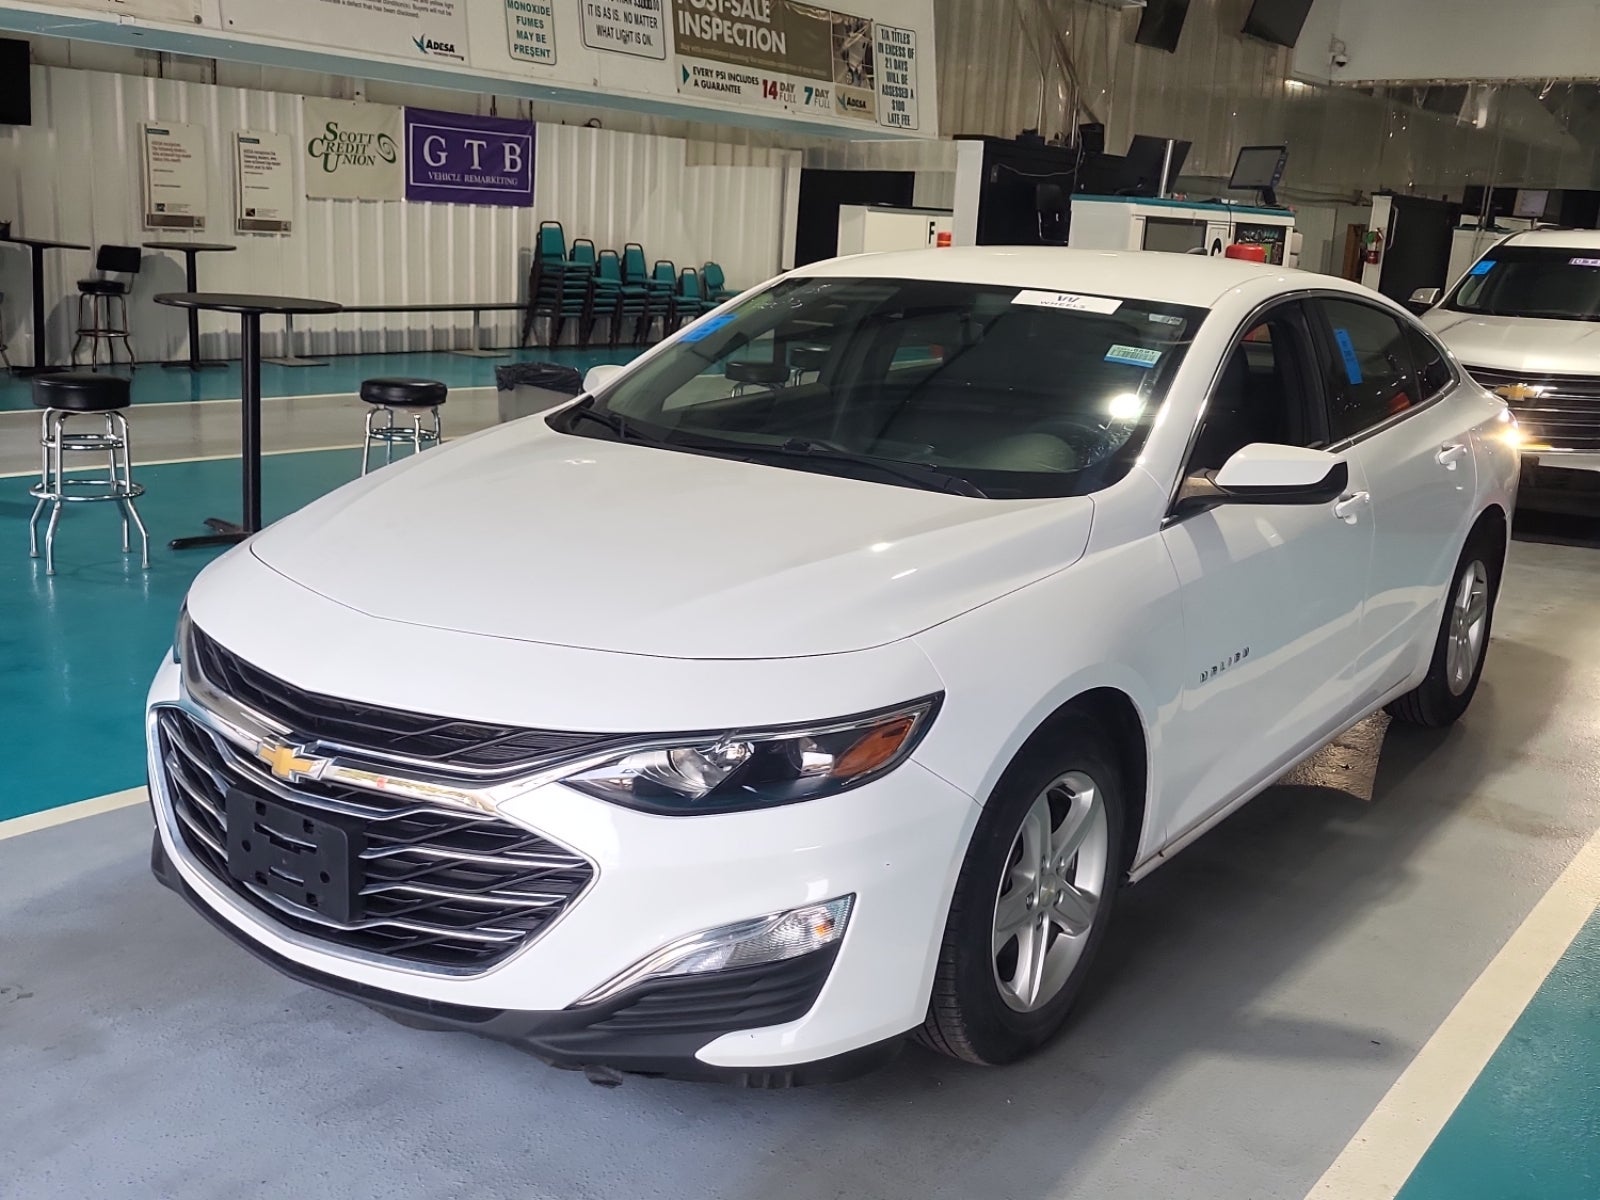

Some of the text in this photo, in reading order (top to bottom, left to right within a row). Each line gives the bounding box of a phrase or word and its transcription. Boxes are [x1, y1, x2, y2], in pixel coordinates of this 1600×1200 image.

[507, 0, 551, 16] MONOXIDE
[516, 16, 544, 29] FUMES
[587, 4, 593, 17] IT
[594, 5, 602, 18] IS
[603, 6, 612, 20] AS
[623, 11, 632, 24] NO
[634, 13, 658, 29] MATTER
[516, 30, 547, 44] MAY BE
[596, 24, 614, 38] WHAT
[615, 27, 634, 43] LIGHT
[635, 30, 642, 43] IS
[678, 10, 786, 55] INSPECTION
[891, 30, 911, 45] TITLES
[426, 39, 455, 53] ADESA
[514, 44, 551, 58] PRESENT
[878, 42, 914, 59] IN EXCESS OF
[885, 57, 908, 72] 21 DAYS
[692, 66, 759, 86] EVERY PSI INCLUDES
[886, 71, 908, 85] WILL BE
[693, 79, 742, 95] A GUARANTEE
[762, 79, 796, 100] 14 DAY
[881, 84, 914, 99] ASSESSED A
[780, 93, 797, 104] FULL
[804, 86, 830, 105] 7 DAY
[846, 97, 867, 109] ADESA
[815, 99, 831, 109] FULL
[892, 99, 905, 112] $100
[887, 112, 911, 126] LATE FEE
[322, 121, 376, 144] SCOTT
[307, 137, 370, 158] CREDIT
[322, 152, 376, 173] UNION
[428, 171, 518, 186] VEHICLE REMARKETING
[928, 221, 936, 244] F
[1041, 300, 1086, 309] WHEELS
